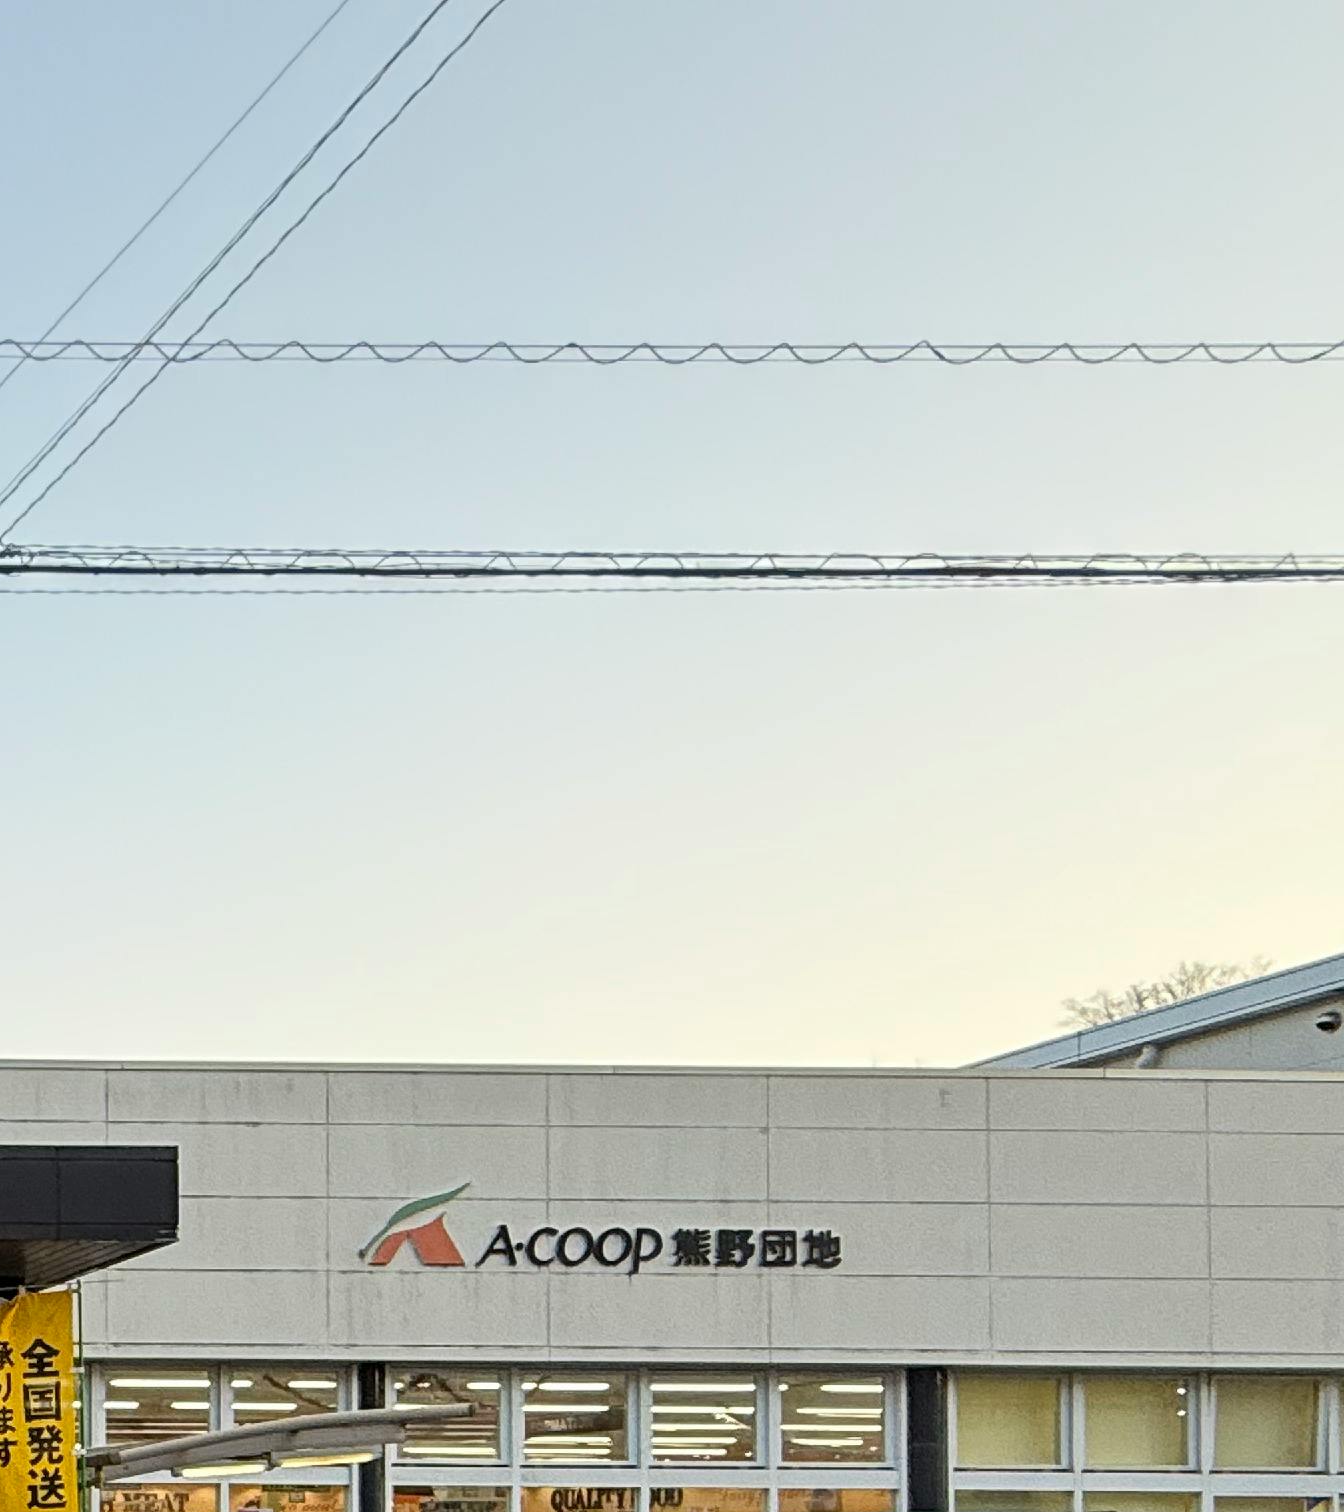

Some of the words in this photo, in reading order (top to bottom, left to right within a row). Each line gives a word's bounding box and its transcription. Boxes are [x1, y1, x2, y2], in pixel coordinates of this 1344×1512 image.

[671, 1229, 843, 1268] 熊野団地
[21, 1338, 67, 1510] 全国発送
